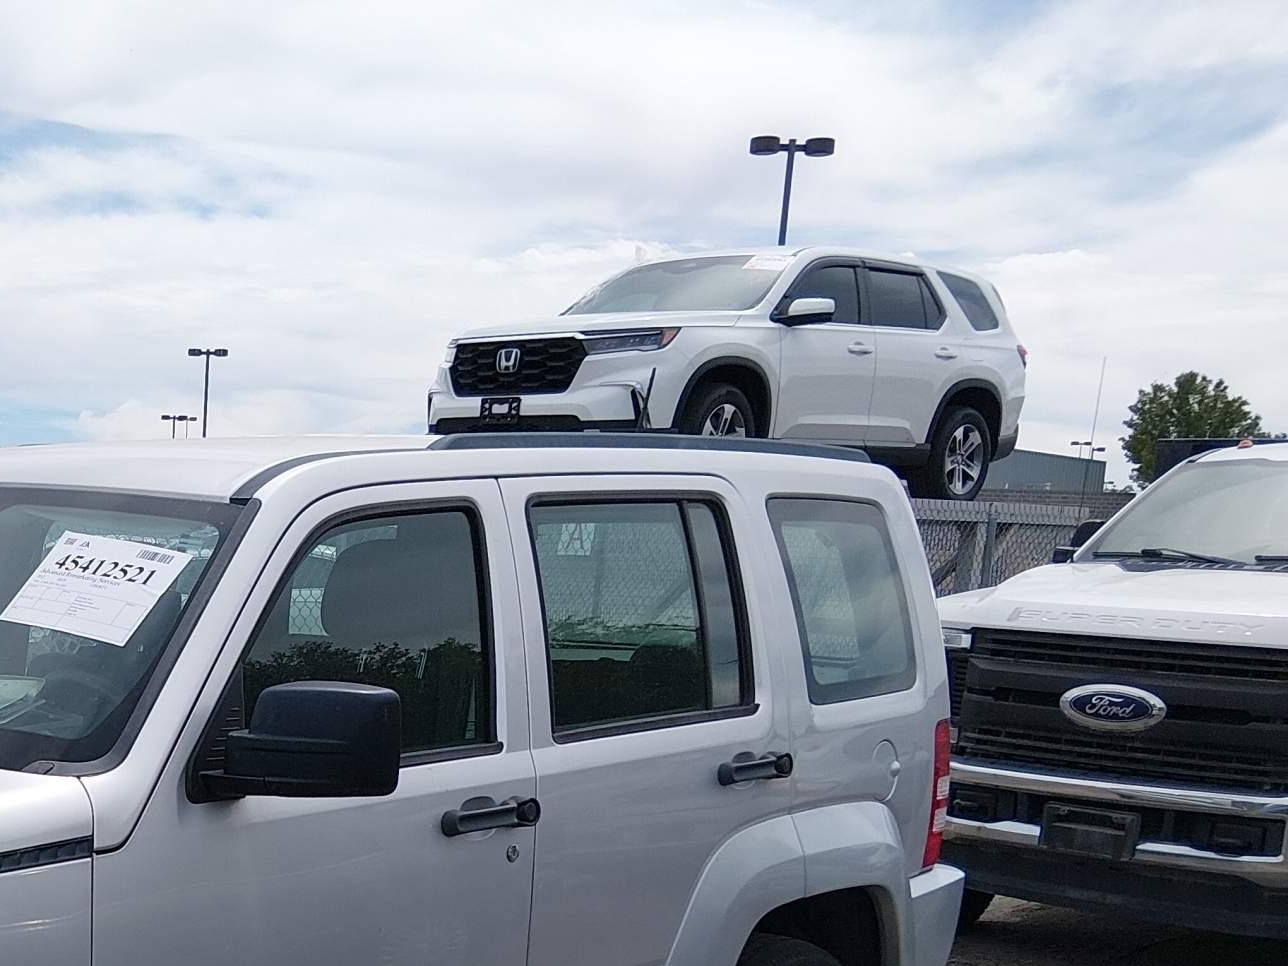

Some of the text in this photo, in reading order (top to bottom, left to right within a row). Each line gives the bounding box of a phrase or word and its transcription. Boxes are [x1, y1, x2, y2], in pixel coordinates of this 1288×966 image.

[55, 553, 157, 586] 45412521
[1016, 607, 1264, 635] SUPER DUTY
[1085, 695, 1135, 718] Ford
